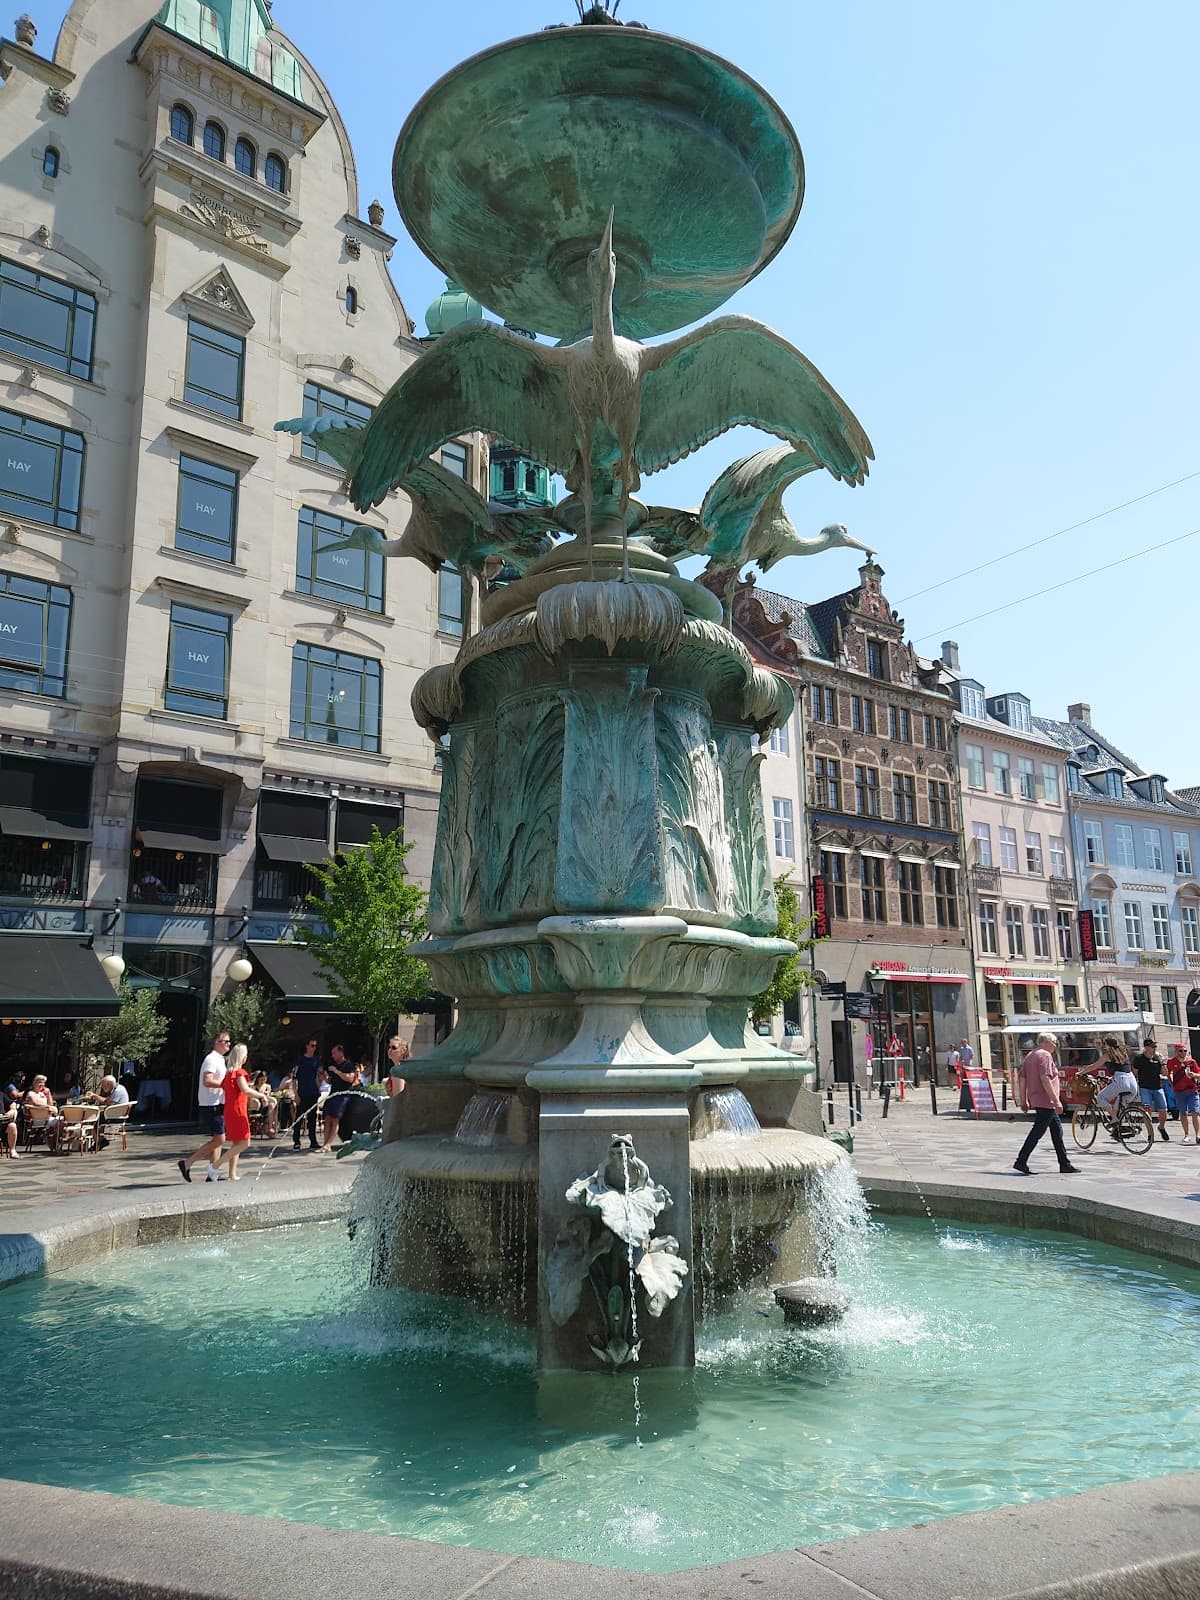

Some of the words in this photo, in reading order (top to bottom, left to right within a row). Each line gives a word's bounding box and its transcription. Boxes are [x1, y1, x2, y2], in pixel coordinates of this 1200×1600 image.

[7, 458, 32, 473] HAY
[195, 503, 216, 516] HAY
[332, 555, 350, 566] HAY
[0, 622, 18, 634] AY
[188, 651, 210, 663] HAY
[1082, 919, 1094, 958] FRIDAYS
